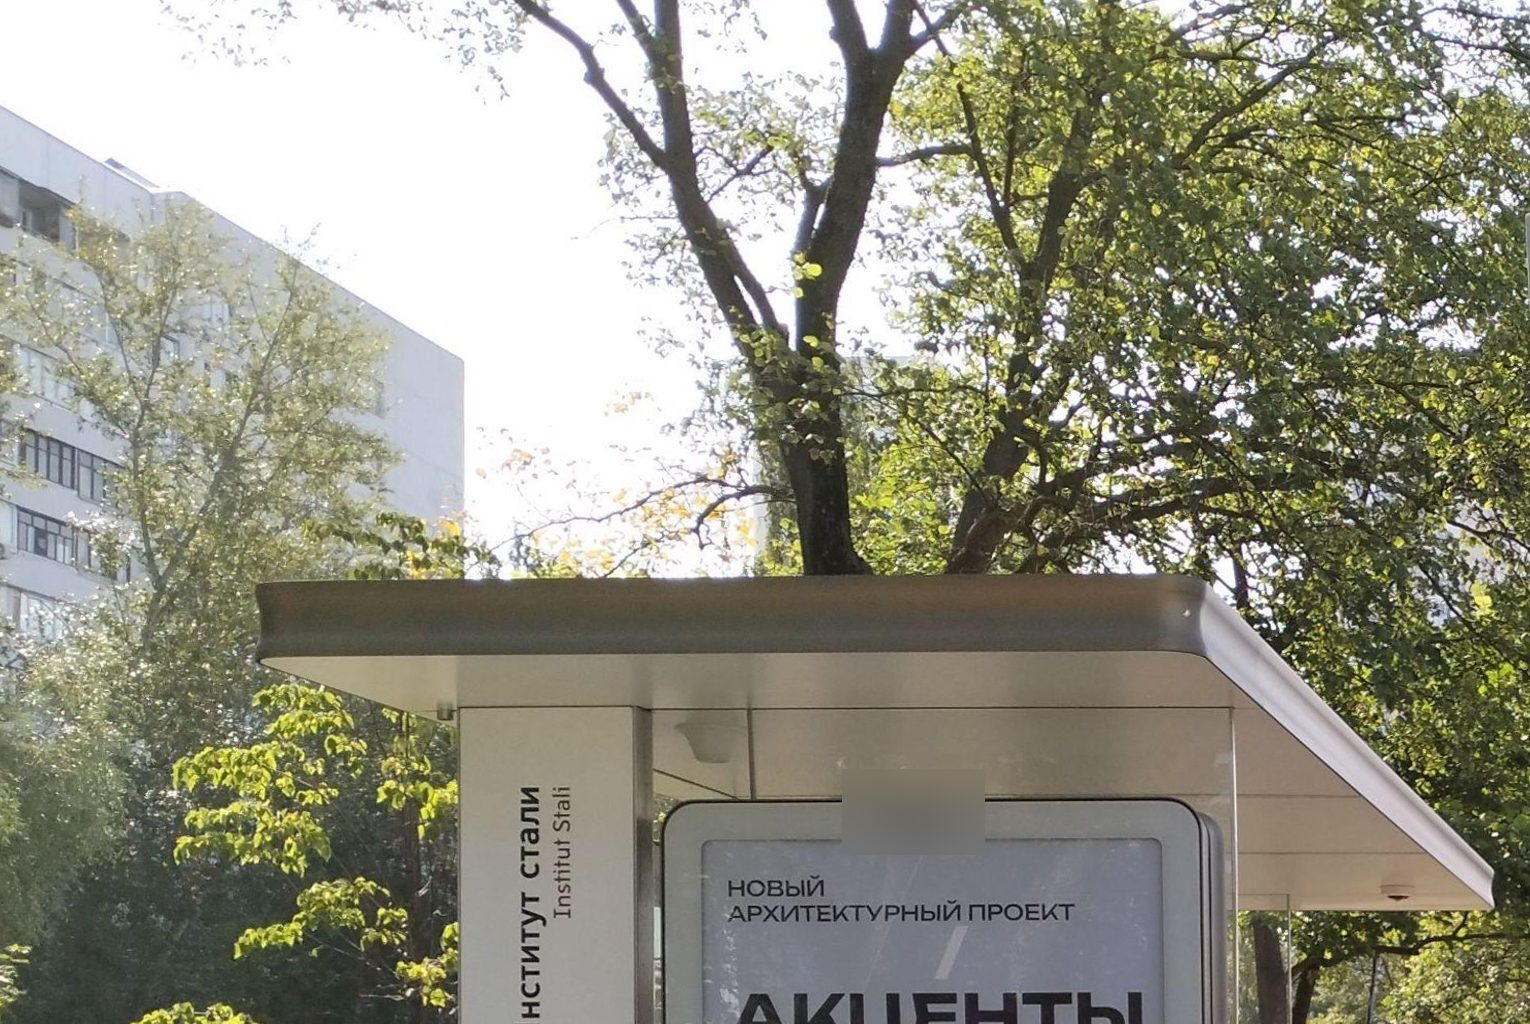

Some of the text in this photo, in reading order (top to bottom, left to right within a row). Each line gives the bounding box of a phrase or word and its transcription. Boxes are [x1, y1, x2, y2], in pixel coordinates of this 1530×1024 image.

[520, 786, 541, 880] стали
[552, 785, 572, 919] Institut Stali
[727, 874, 825, 898] НОВЫЙ
[727, 899, 1077, 923] АРХИТЕКТУРНЫЙ ПРОЕКТ
